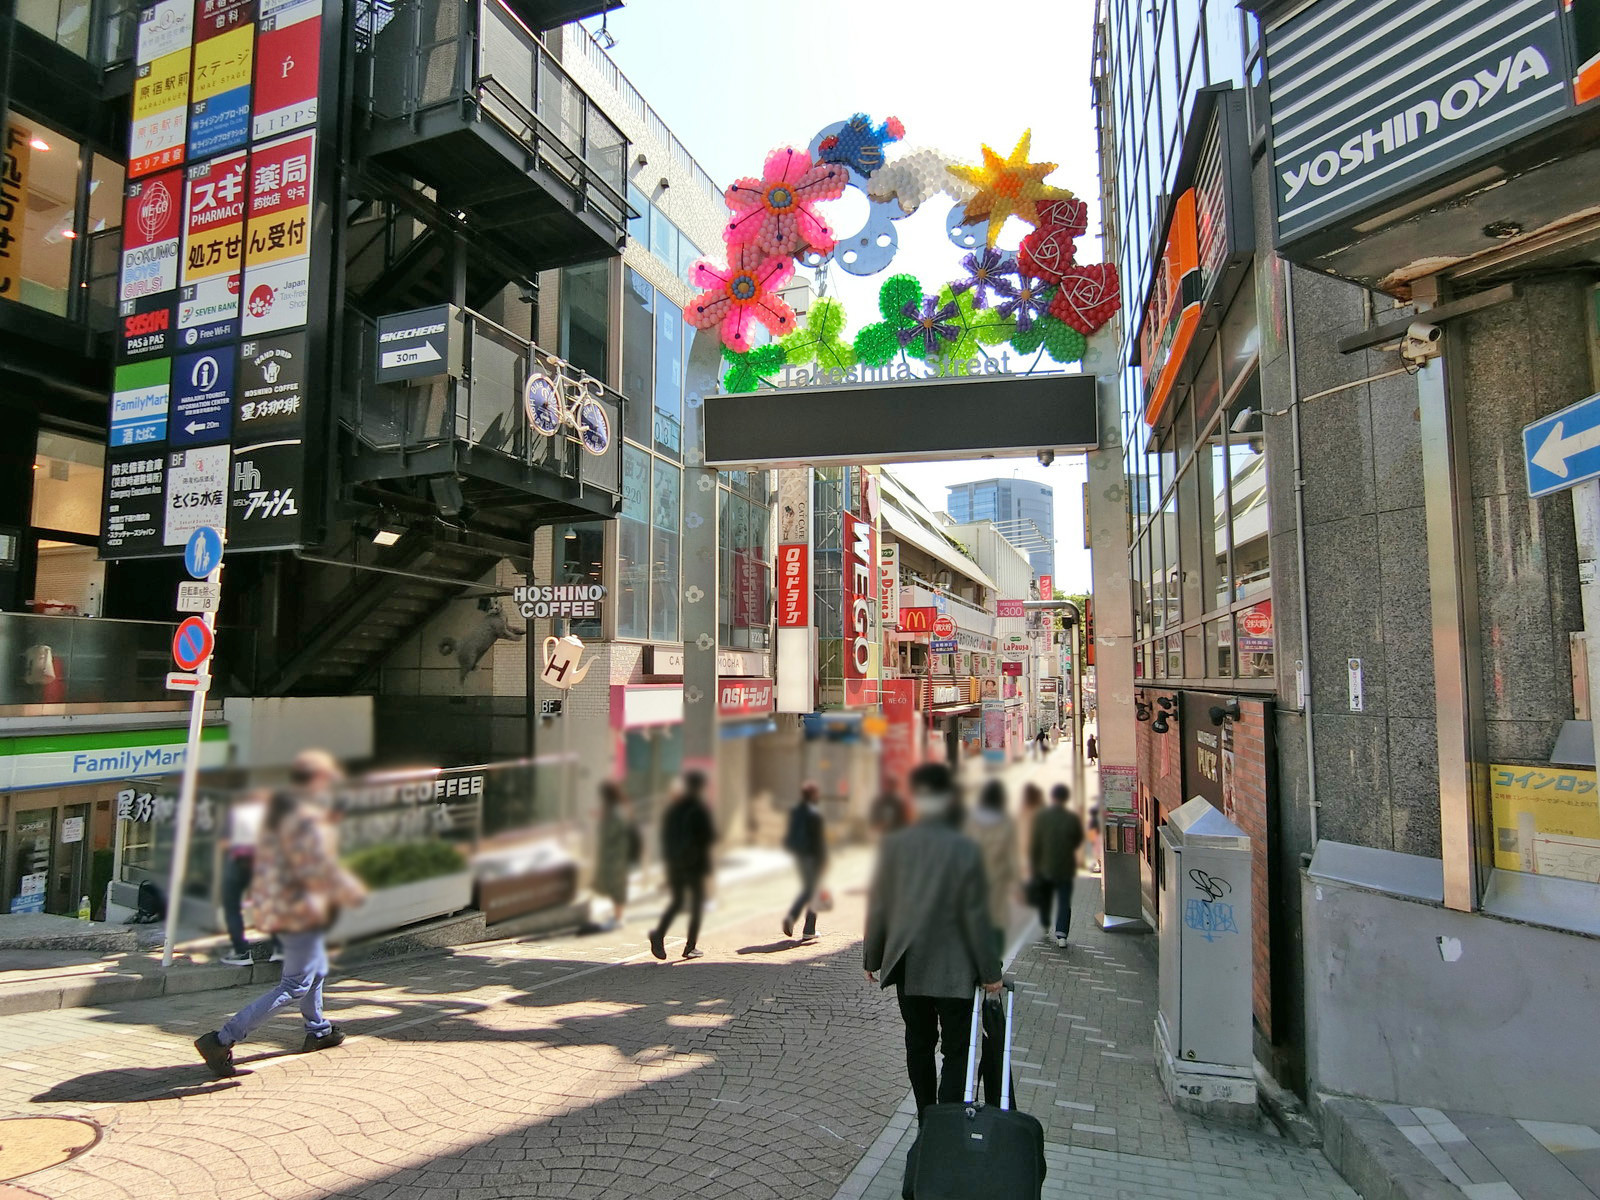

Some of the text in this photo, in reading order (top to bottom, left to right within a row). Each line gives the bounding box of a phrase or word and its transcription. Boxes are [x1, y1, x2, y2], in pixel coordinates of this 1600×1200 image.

[261, 18, 275, 32] 4F
[139, 66, 150, 77] 6F
[140, 49, 250, 100] 原宿駅前 ステージ
[194, 103, 207, 114] 5F
[255, 106, 318, 134] LIPPS
[1282, 46, 1549, 202] YOSHINOYA
[134, 148, 182, 171] エリア原宿
[188, 164, 211, 179] 1F/2F
[129, 184, 142, 197] 3F
[192, 155, 307, 212] スギ 薬局
[191, 202, 244, 227] PHARMACY
[188, 217, 306, 270] 処方せ ん受付
[126, 242, 179, 268] DOKUMO
[125, 276, 163, 298] GIRLS!
[284, 279, 306, 290] Japan
[183, 288, 193, 299] 1F
[280, 290, 307, 301] Tax-free
[122, 302, 134, 314] 1F
[195, 306, 217, 317] SEVEN
[218, 302, 237, 312] BANK
[200, 325, 231, 338] Free Wi-Fi
[379, 323, 446, 343] SKECHERS
[128, 338, 142, 350] PAS
[149, 333, 165, 346] PAS
[243, 343, 257, 356] BF
[396, 353, 418, 363] 30m
[782, 350, 1012, 387] Takeshita Street
[115, 394, 169, 412] FamilyMart
[241, 395, 301, 422] 星乃珈琲
[172, 453, 184, 466] BF
[173, 490, 224, 508] さくら水産
[514, 585, 602, 602] HOSHINO
[785, 548, 801, 624] OSドラッグ
[852, 522, 870, 675] WEGO
[521, 601, 595, 618] COFFEE
[999, 607, 1022, 616] ¥300
[545, 654, 570, 682] H
[722, 686, 771, 707] OSドラッグ
[542, 700, 554, 713] BF
[1495, 771, 1597, 794] コインロッ
